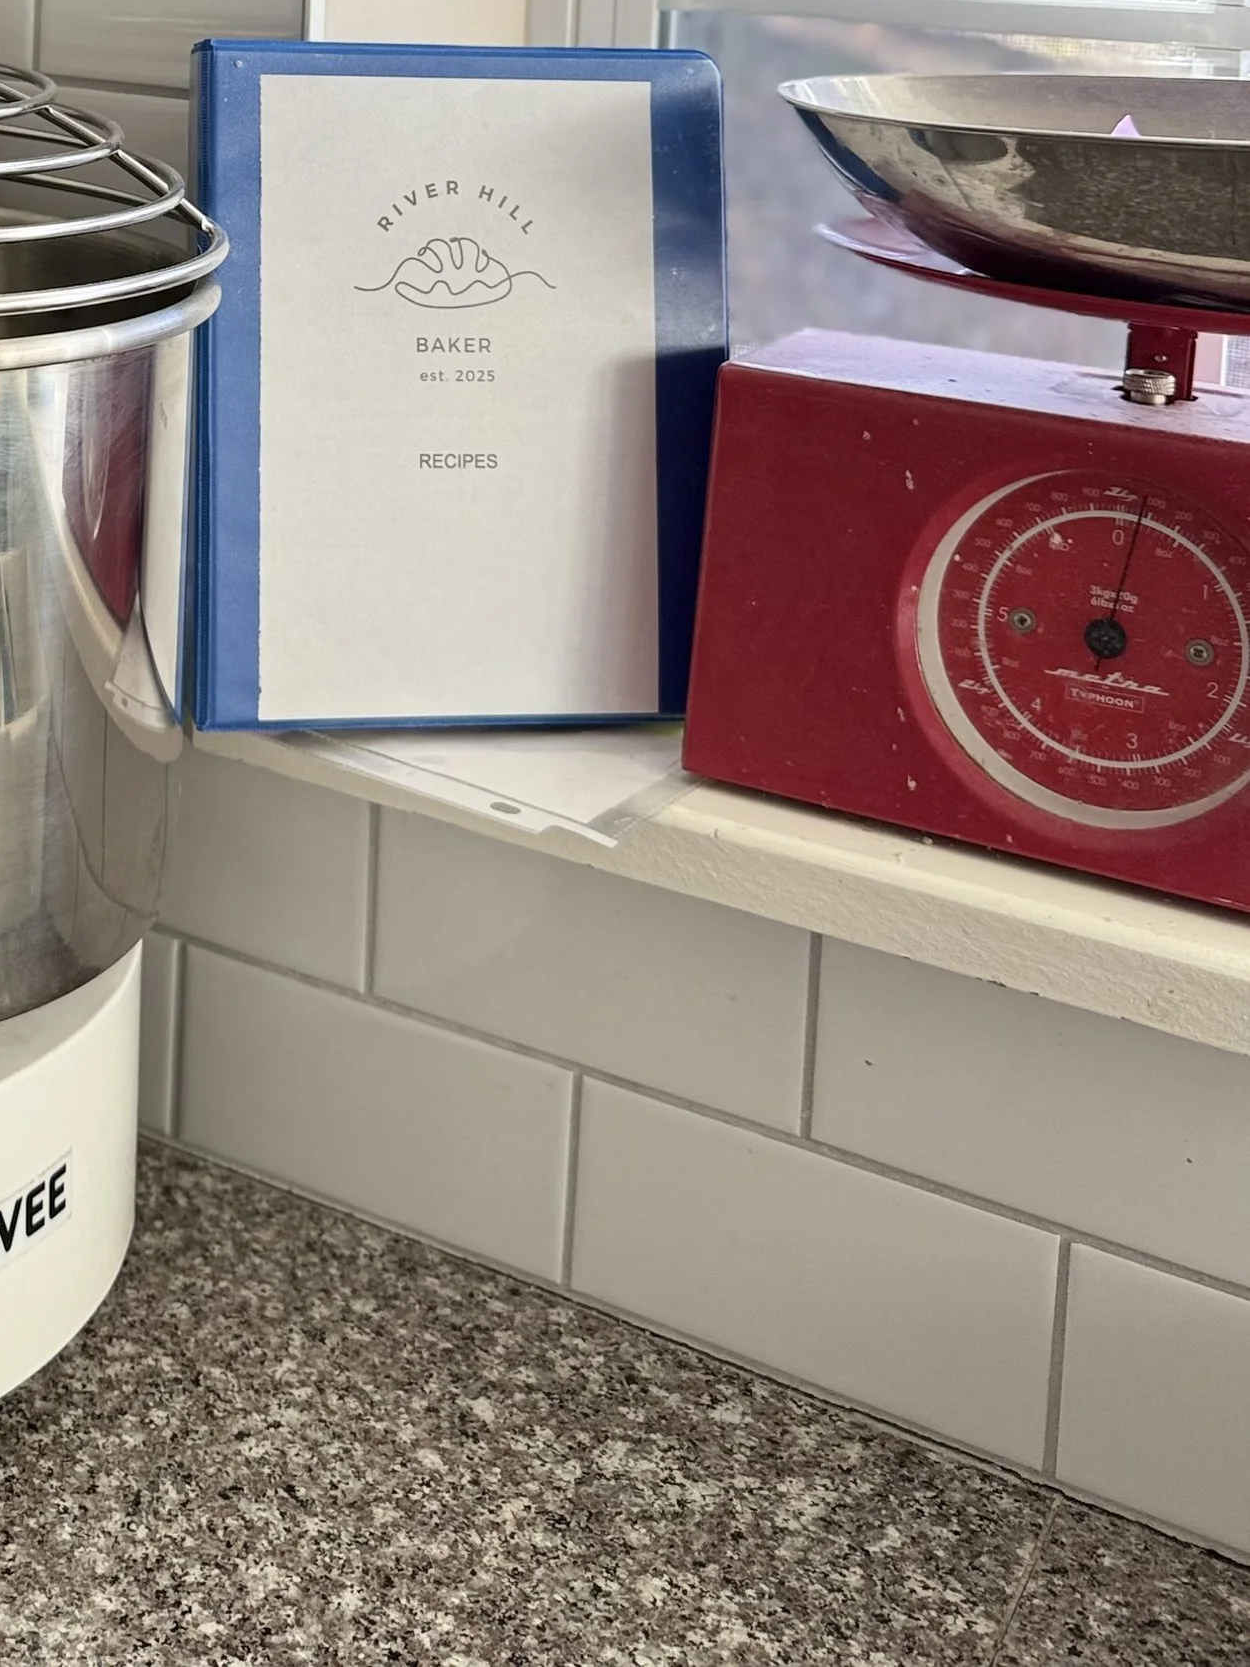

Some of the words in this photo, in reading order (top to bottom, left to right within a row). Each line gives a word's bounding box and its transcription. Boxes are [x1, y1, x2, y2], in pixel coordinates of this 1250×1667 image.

[376, 180, 459, 232] RIVER
[477, 185, 534, 234] HILL
[415, 337, 492, 353] BAKER
[419, 369, 449, 382] est.
[454, 369, 496, 382] 2025
[418, 453, 499, 469] RECIPES
[1112, 529, 1125, 546] 0
[996, 606, 1009, 623] 5
[1069, 687, 1134, 709] TYPHOON
[1205, 681, 1220, 699] 2
[1031, 696, 1043, 712] 4
[1125, 732, 1138, 749] 3
